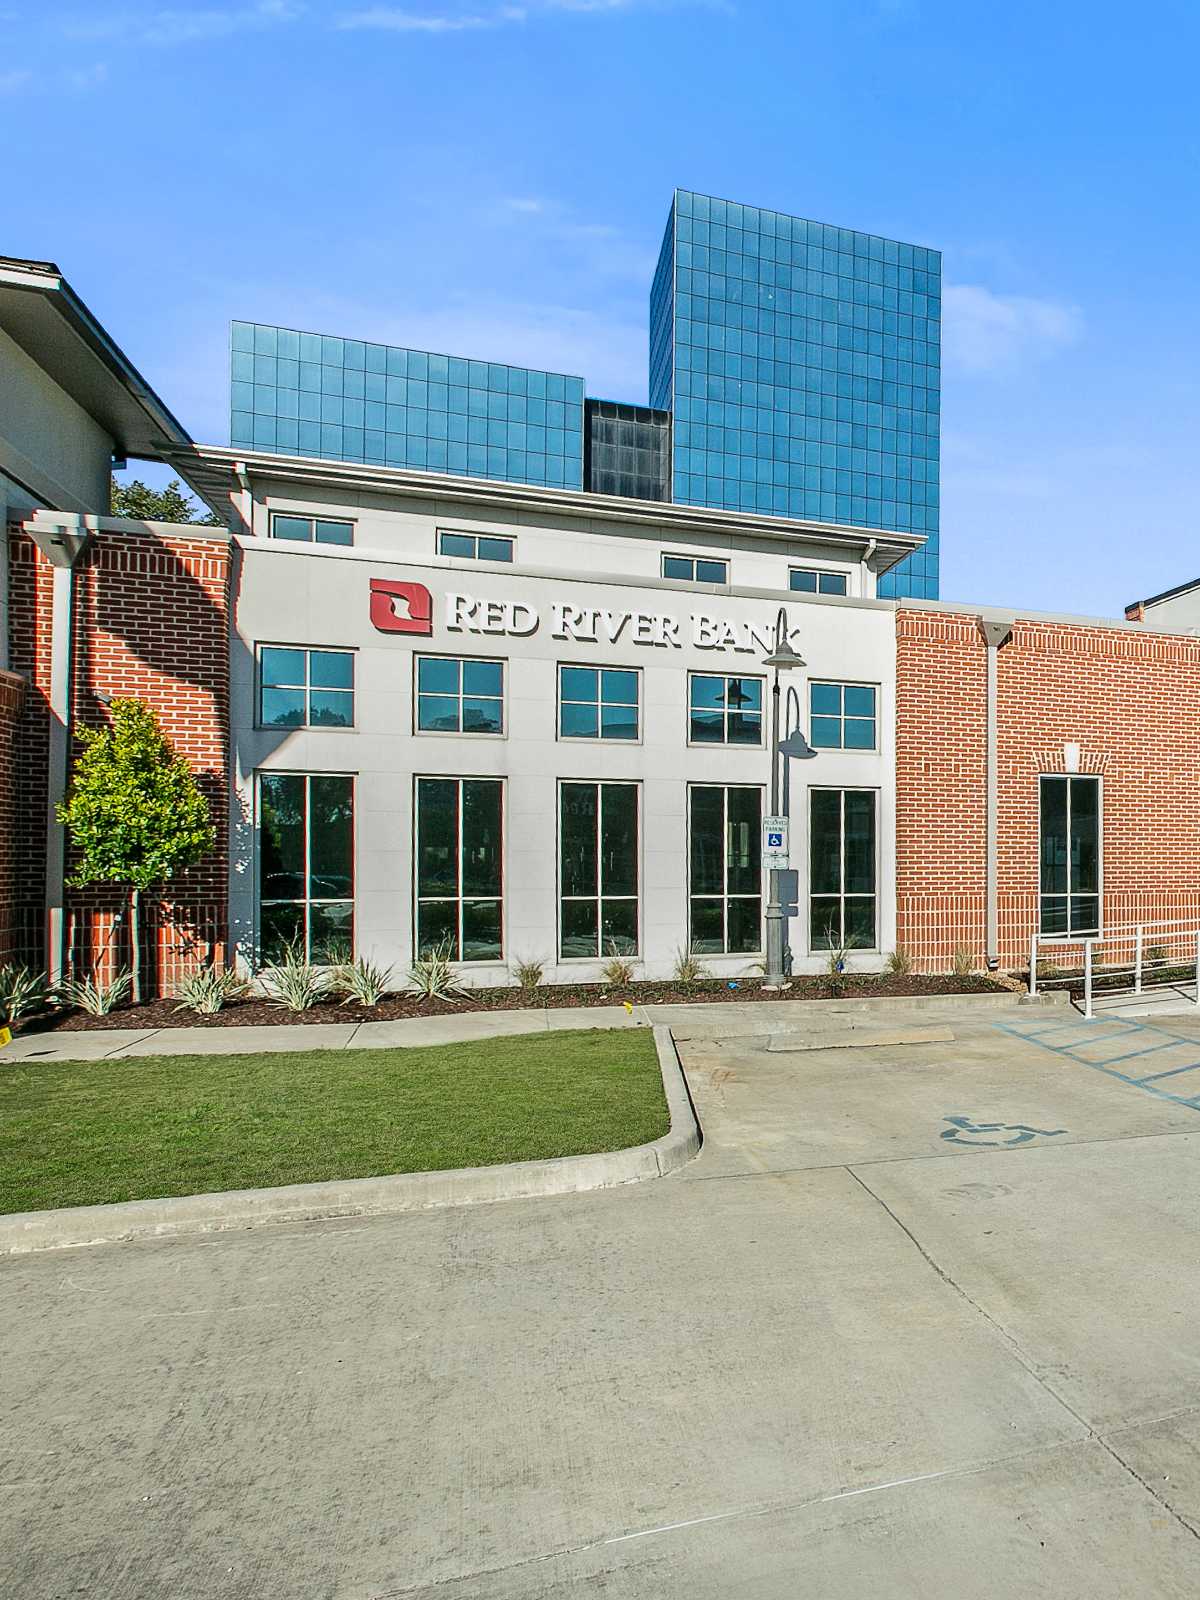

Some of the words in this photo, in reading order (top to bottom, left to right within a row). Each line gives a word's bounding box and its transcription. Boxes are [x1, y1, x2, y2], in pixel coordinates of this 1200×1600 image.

[444, 592, 539, 637] RED
[551, 601, 682, 647] RIVER
[689, 614, 801, 656] BANK
